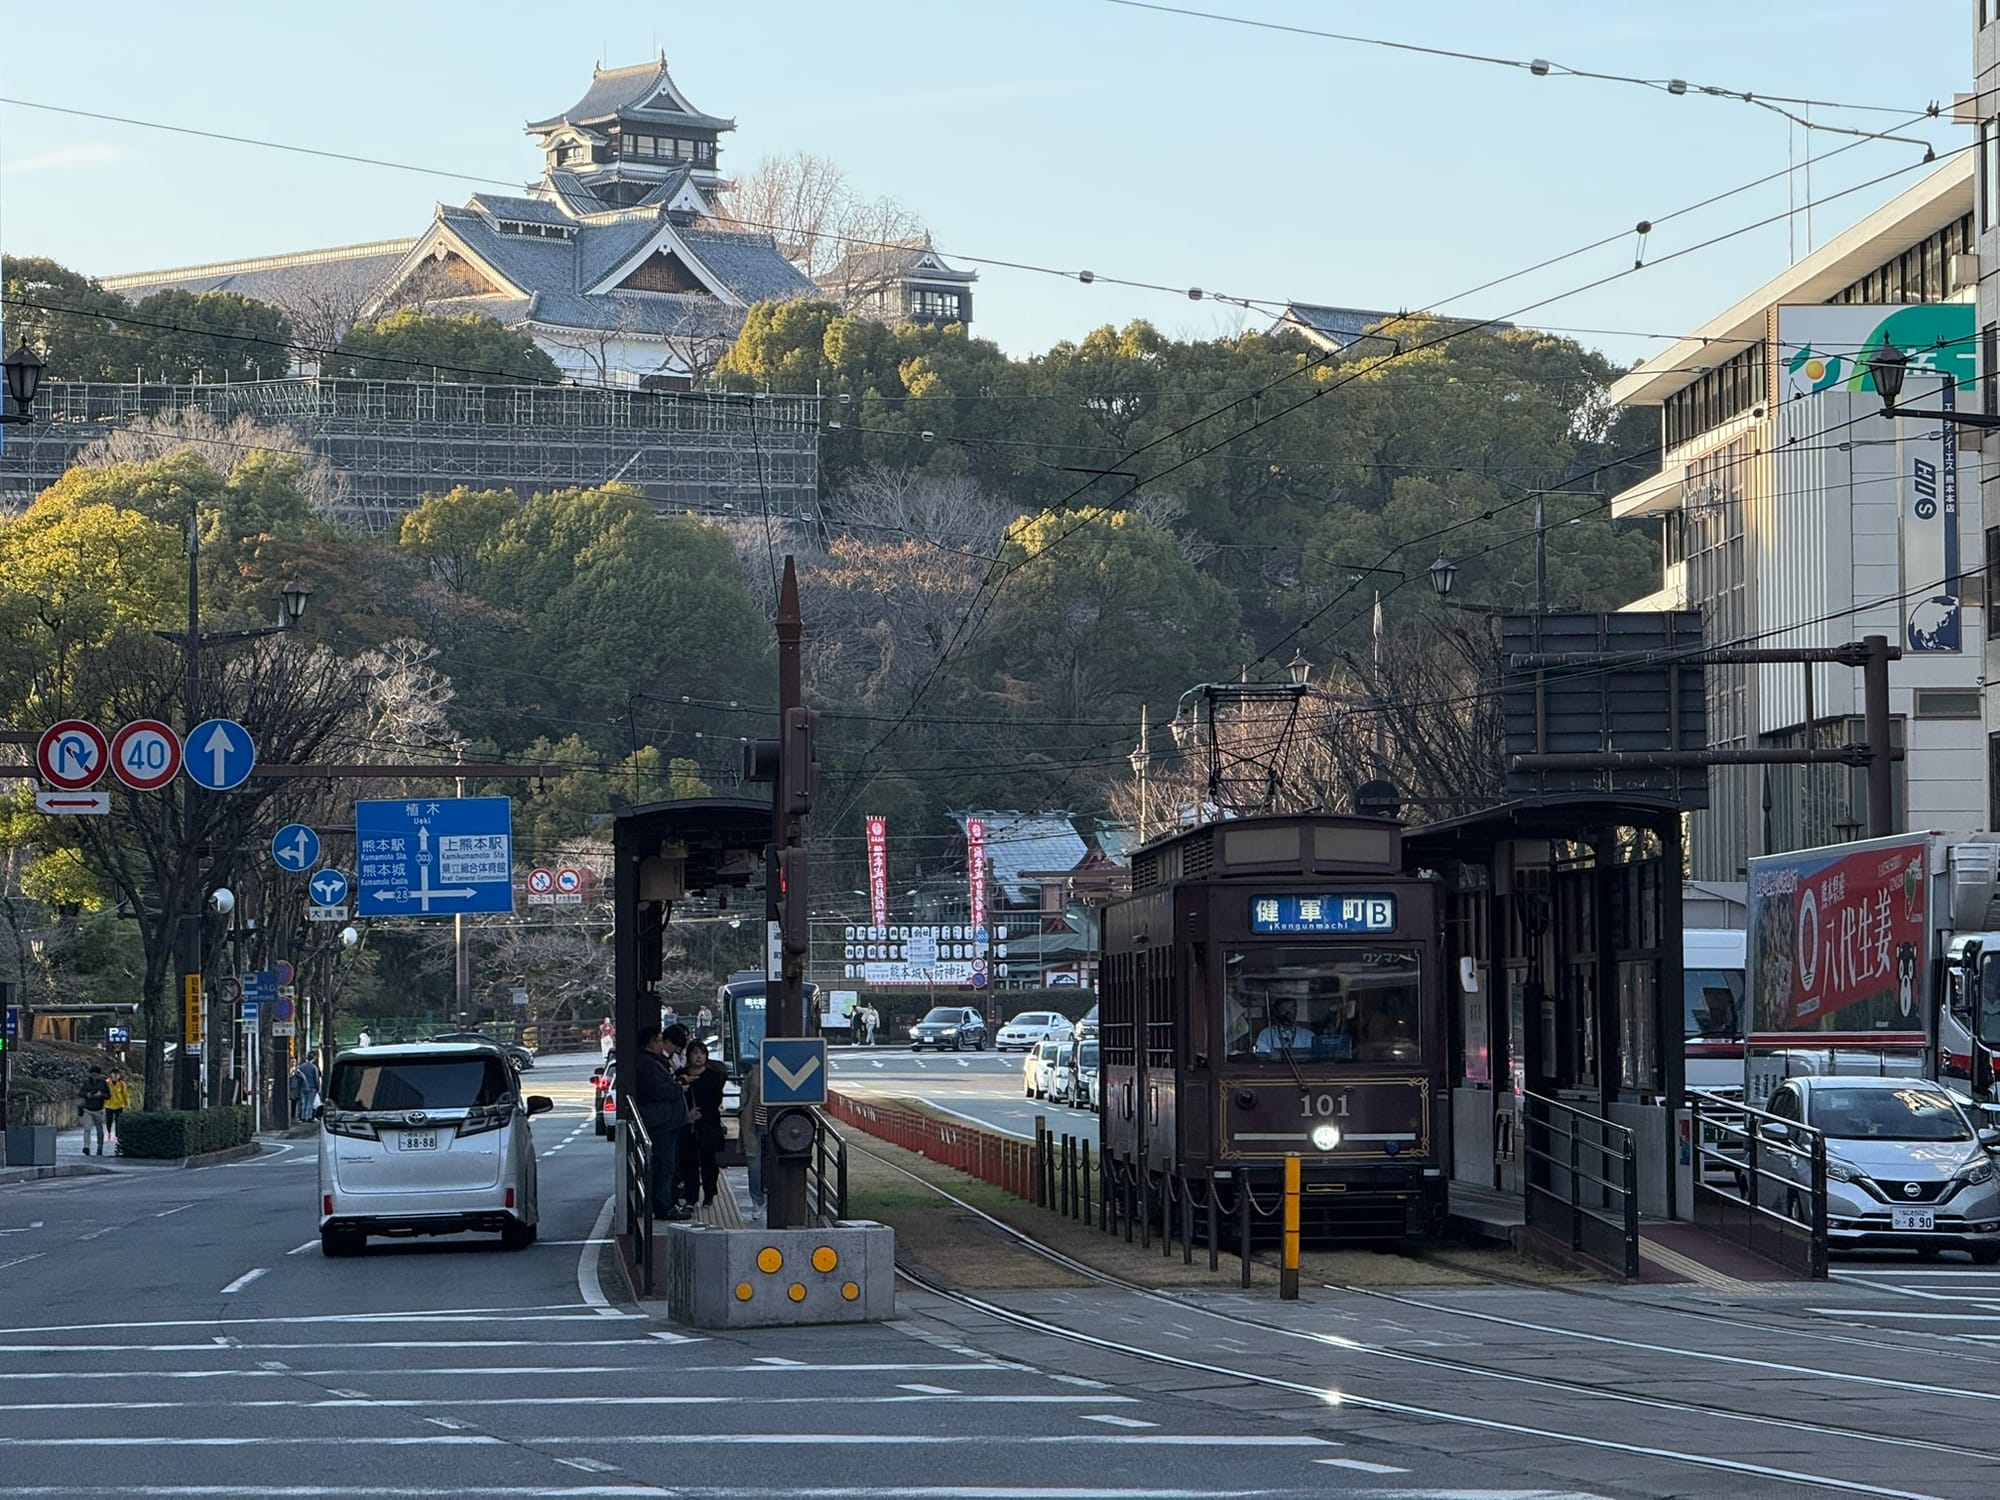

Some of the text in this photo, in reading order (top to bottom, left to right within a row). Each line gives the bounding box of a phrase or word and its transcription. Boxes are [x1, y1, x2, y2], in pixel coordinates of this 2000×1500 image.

[1944, 402, 1956, 513] エチ・アイ・エス 熊本本店
[127, 740, 165, 769] 40
[405, 802, 441, 817] 植木
[362, 839, 406, 853] 熊本駅
[444, 836, 503, 852] 上熊本駅
[360, 853, 394, 861] Kumamoto
[442, 852, 490, 860] Kamikumamoto
[362, 863, 406, 877] 熊本城
[360, 878, 390, 886] Kumamoto
[396, 890, 408, 898] 28
[1256, 899, 1387, 924] 健軍町 B
[1822, 887, 1892, 998] 八代生姜
[1300, 1094, 1350, 1117] 101
